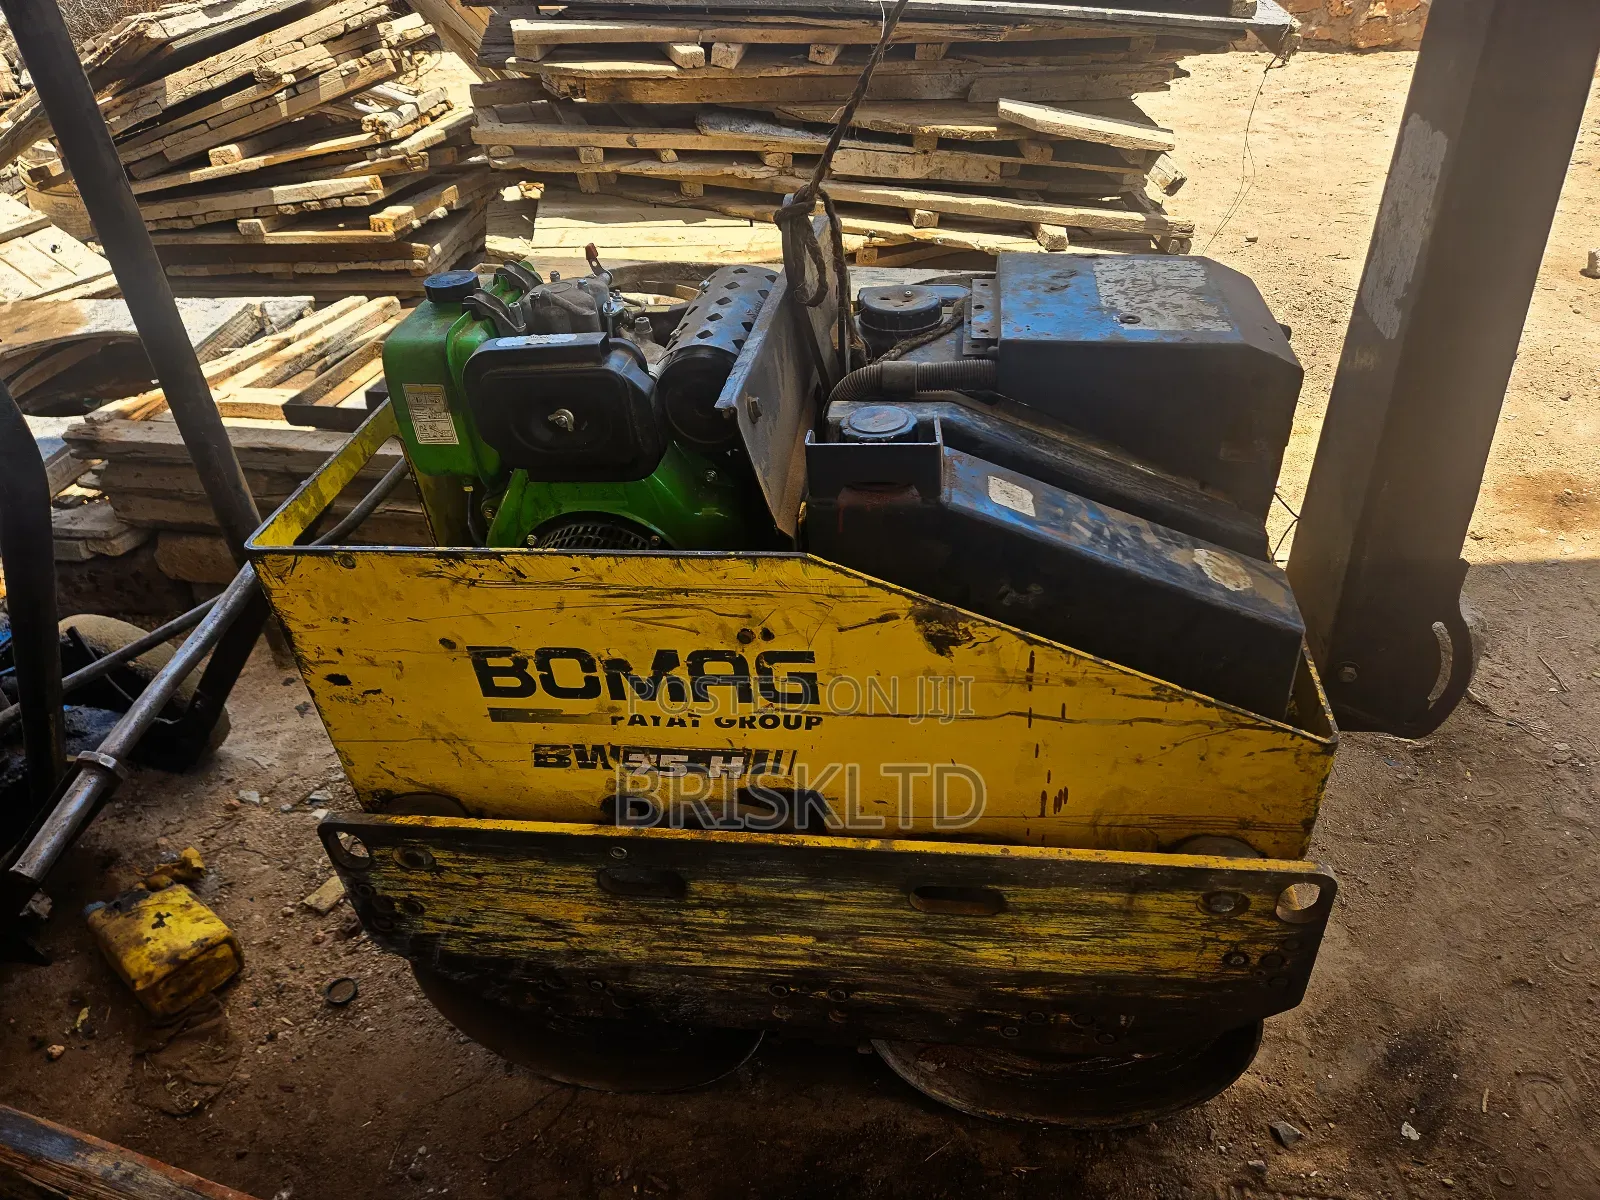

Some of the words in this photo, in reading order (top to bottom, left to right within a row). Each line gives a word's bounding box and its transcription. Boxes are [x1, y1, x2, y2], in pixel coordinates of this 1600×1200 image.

[467, 646, 820, 705] BOMAG
[714, 713, 823, 731] GROUP
[708, 755, 745, 779] H
